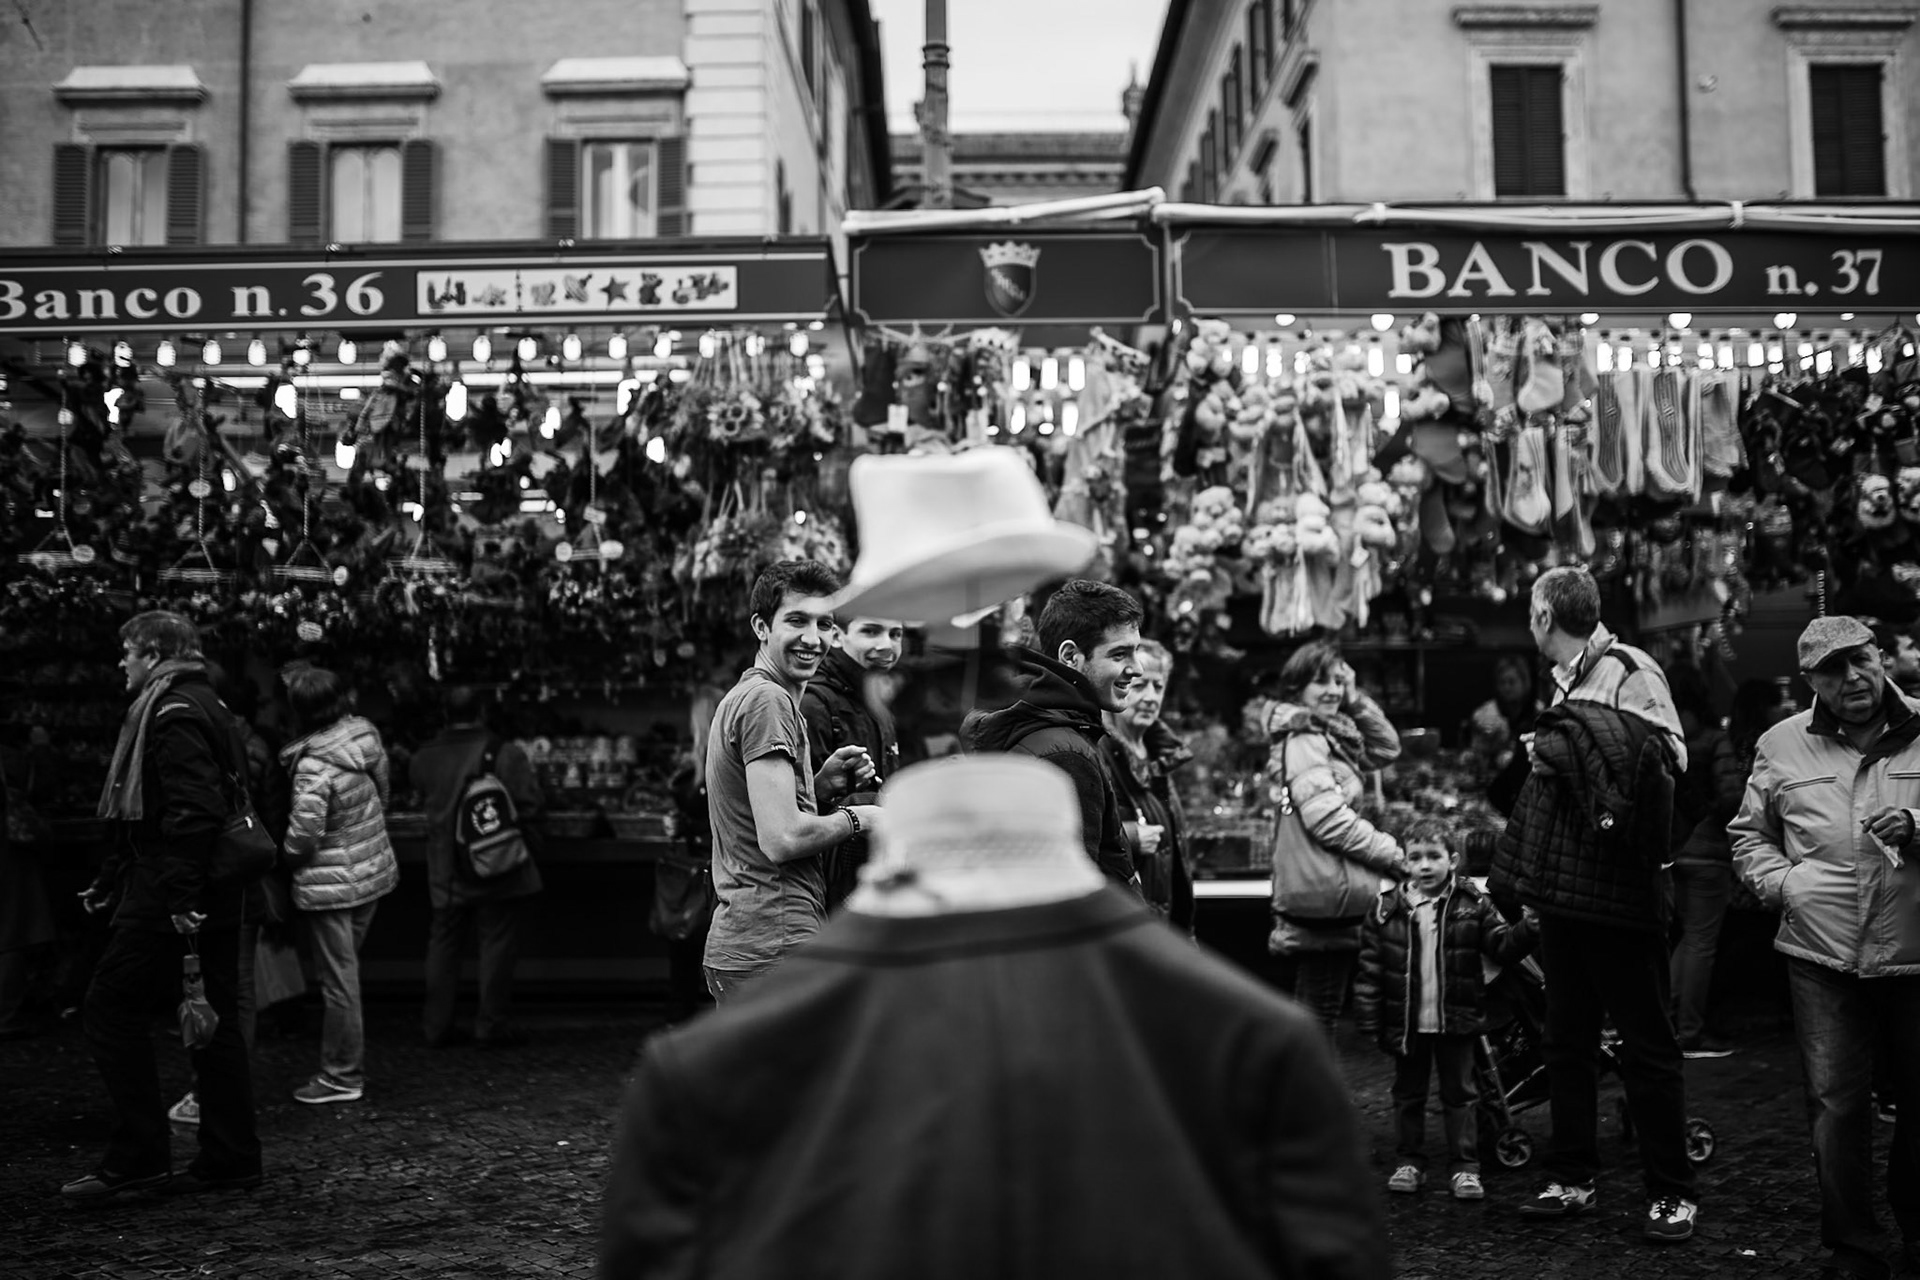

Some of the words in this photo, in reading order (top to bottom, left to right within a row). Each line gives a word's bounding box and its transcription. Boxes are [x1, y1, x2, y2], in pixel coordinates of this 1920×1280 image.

[1381, 239, 1733, 298] BANCO
[1765, 265, 1819, 295] n.
[1831, 250, 1882, 295] 37
[0, 280, 201, 319] Banco
[231, 285, 288, 317] n.
[300, 272, 384, 316] 36
